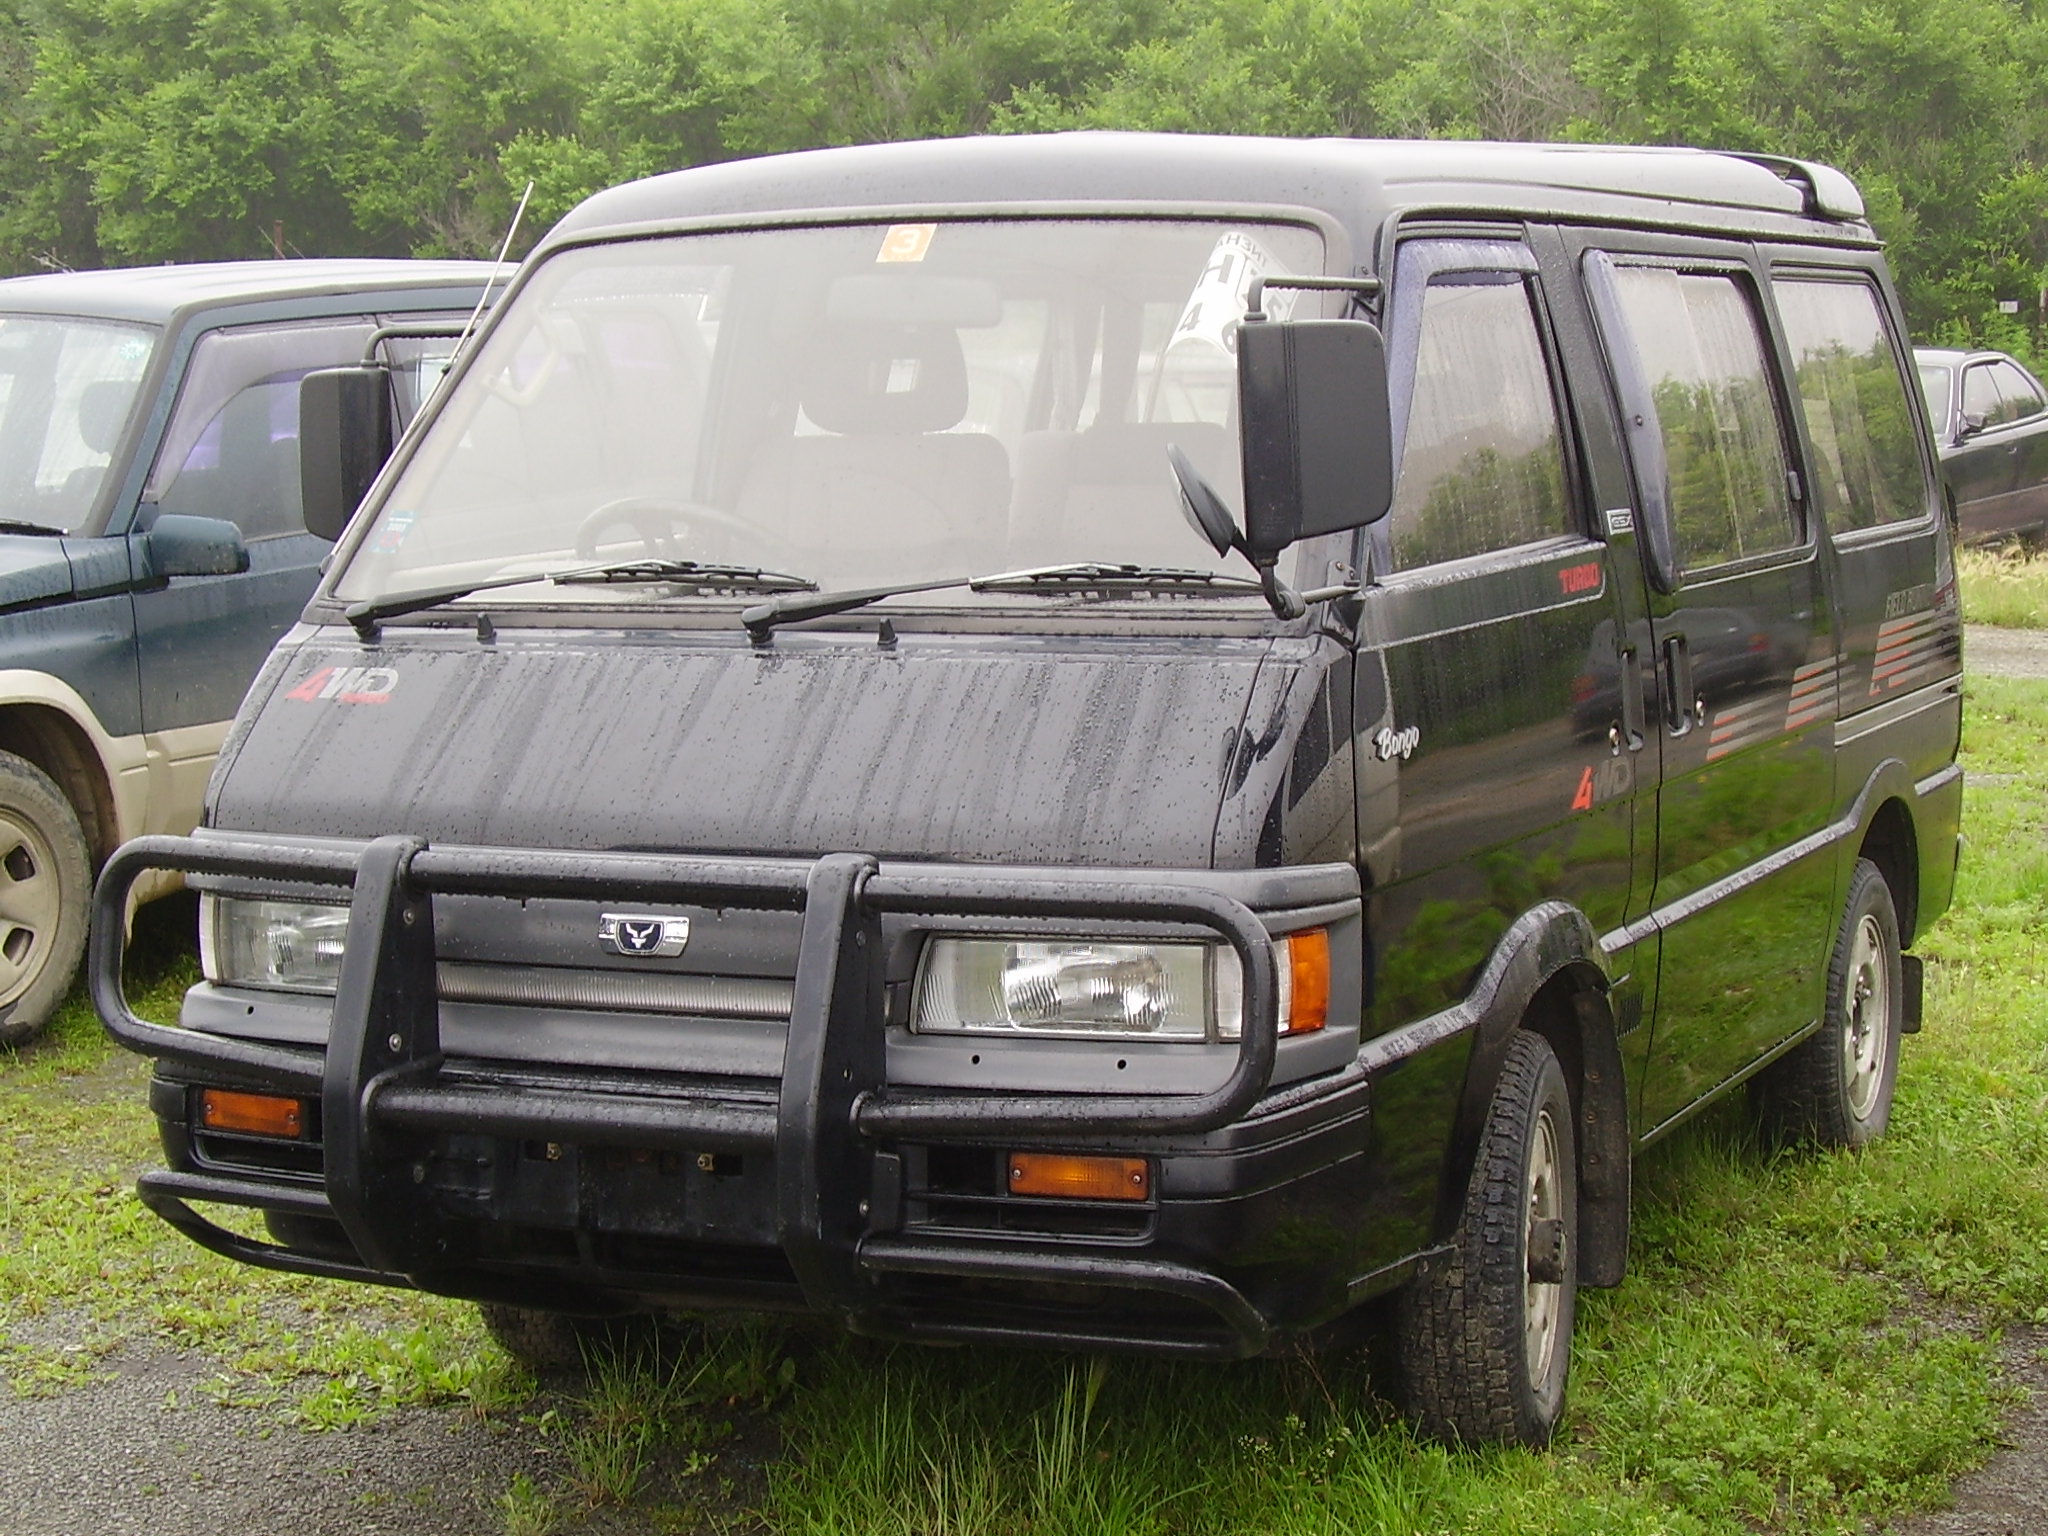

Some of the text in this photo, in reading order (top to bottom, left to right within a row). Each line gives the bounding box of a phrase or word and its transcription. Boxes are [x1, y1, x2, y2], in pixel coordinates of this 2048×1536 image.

[1558, 562, 1601, 595] TURBO
[284, 666, 399, 703] 4WD
[1373, 725, 1421, 761] Bongo
[1571, 756, 1632, 810] 4WD
